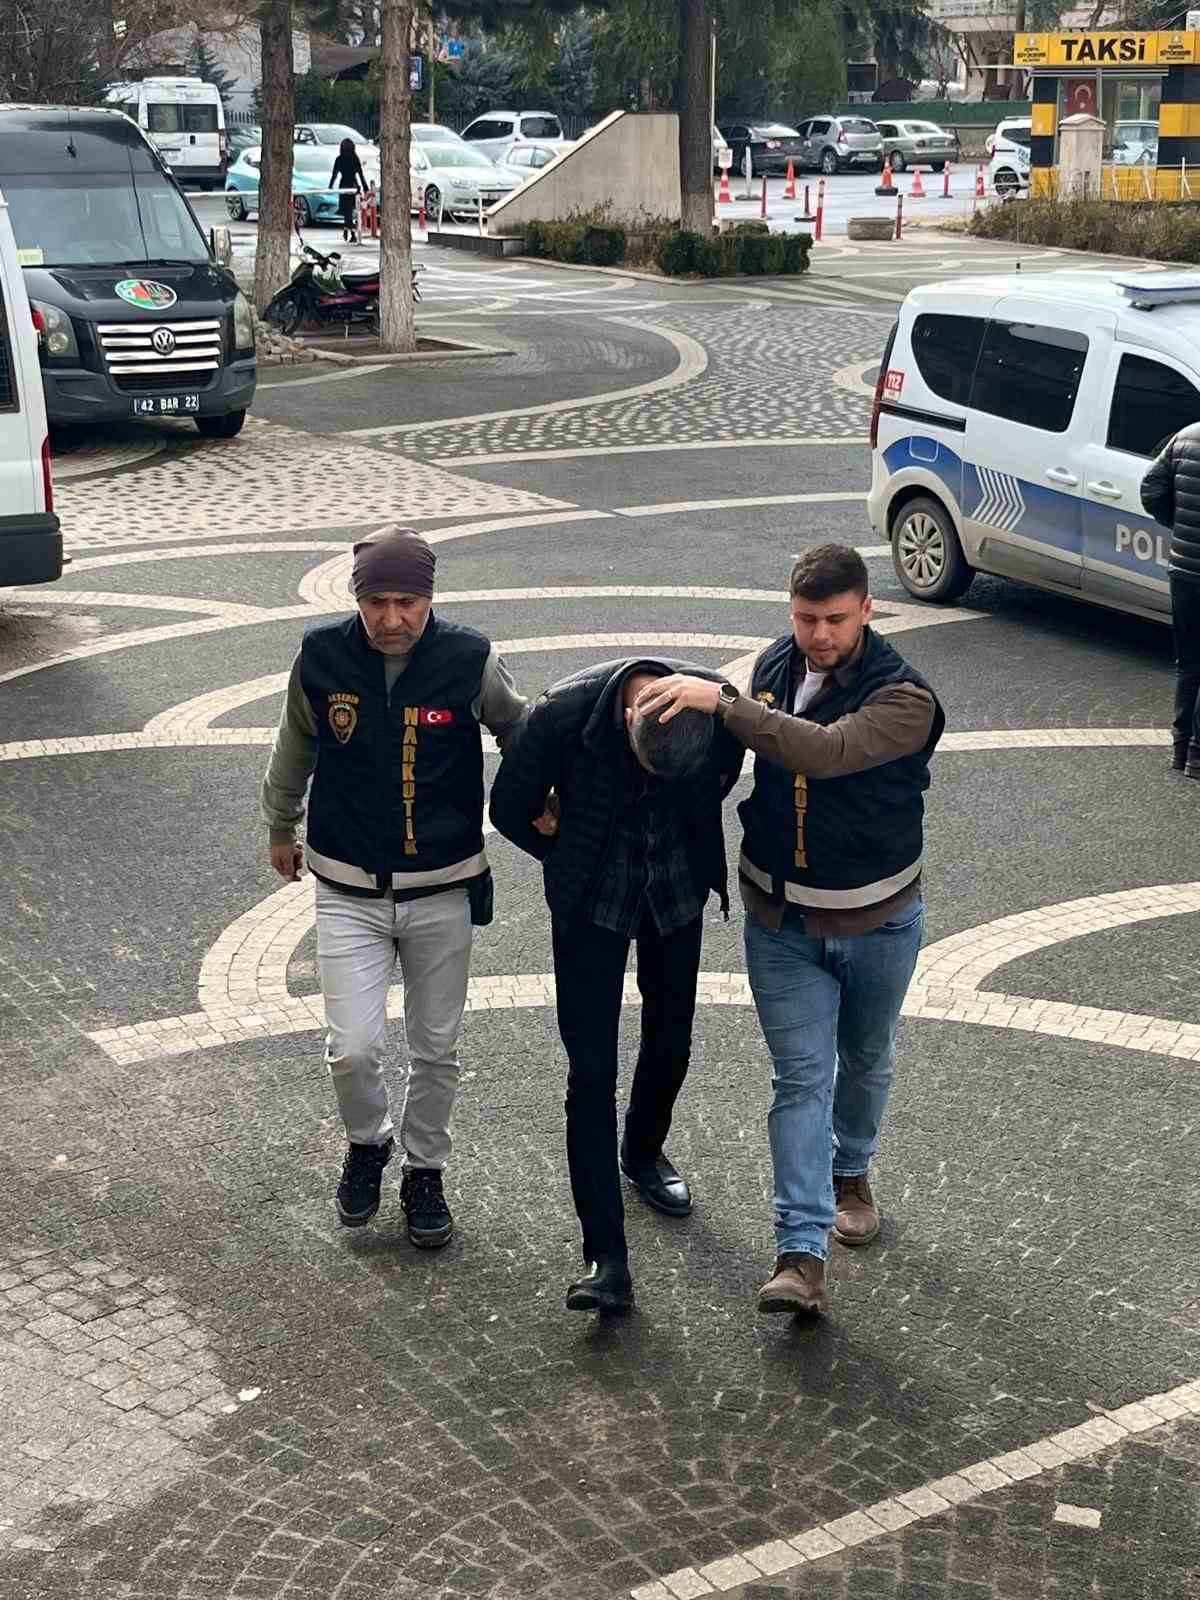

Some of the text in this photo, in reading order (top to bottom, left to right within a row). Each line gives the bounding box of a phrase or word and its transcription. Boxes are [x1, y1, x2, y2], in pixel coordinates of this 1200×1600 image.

[887, 372, 902, 389] 112
[141, 399, 154, 411] 42
[185, 395, 198, 408] 22
[1115, 523, 1169, 567] POL
